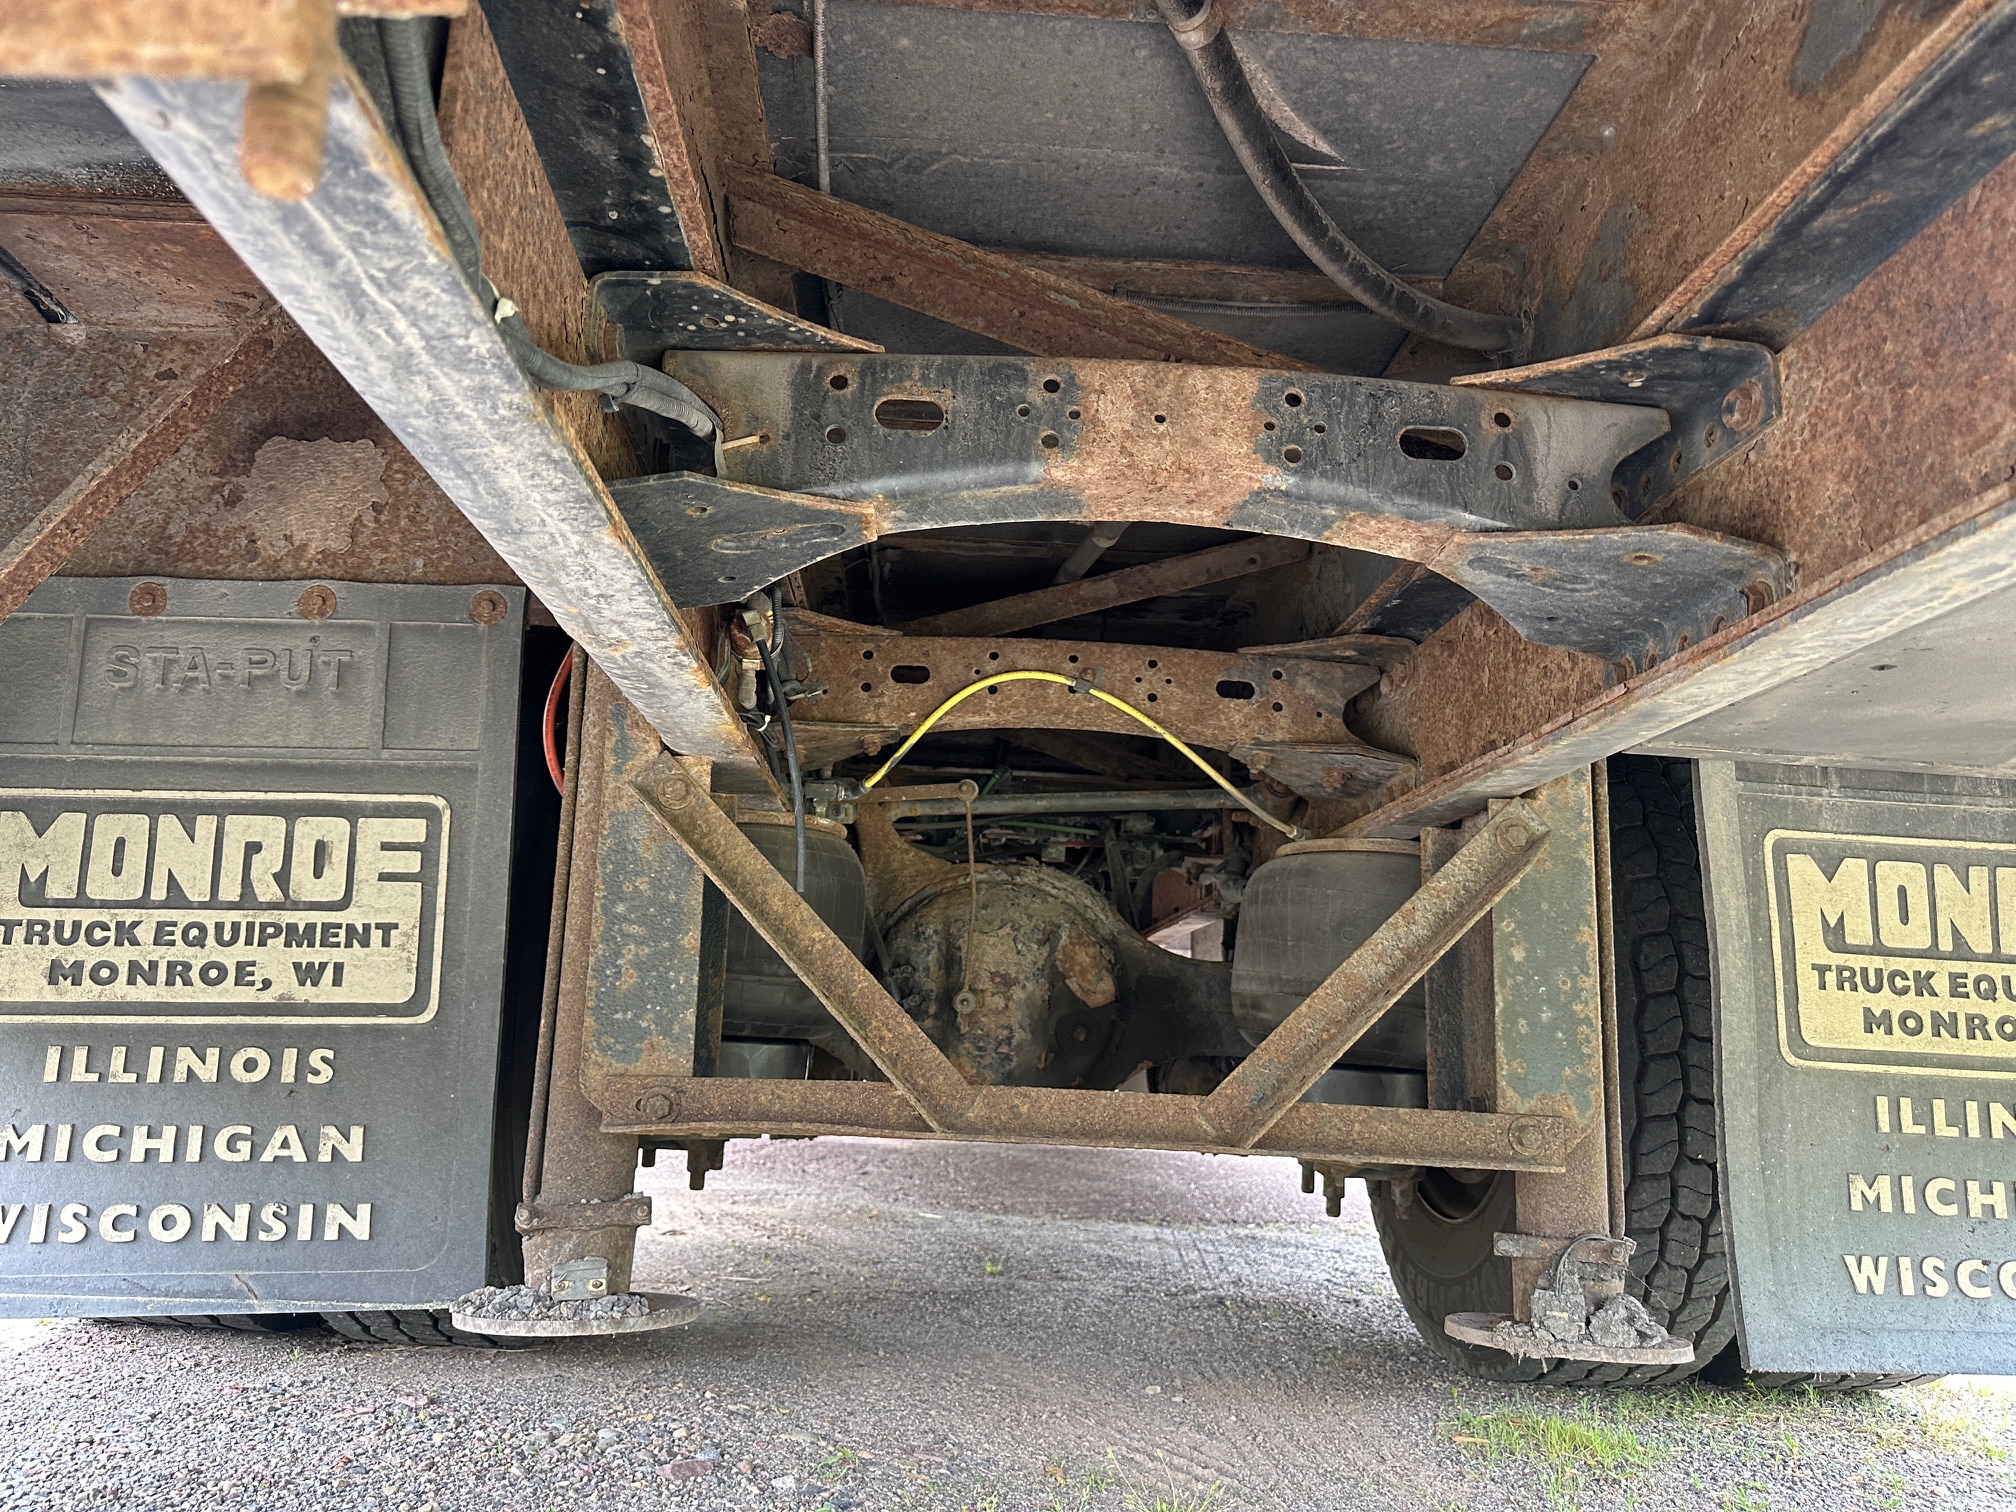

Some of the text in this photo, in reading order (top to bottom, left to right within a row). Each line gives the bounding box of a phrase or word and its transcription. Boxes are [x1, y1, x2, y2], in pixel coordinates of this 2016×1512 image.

[105, 643, 354, 692] STA-PUT
[0, 811, 428, 903] MONROE
[0, 918, 399, 949] TRUCK EQUIPMENT
[48, 958, 345, 992] MONROE, WI
[1811, 962, 1939, 999] TRUCK
[1863, 1006, 2016, 1042] MONRO
[43, 1044, 335, 1085] ILLINOIS
[0, 1122, 366, 1164] MICHIGAN
